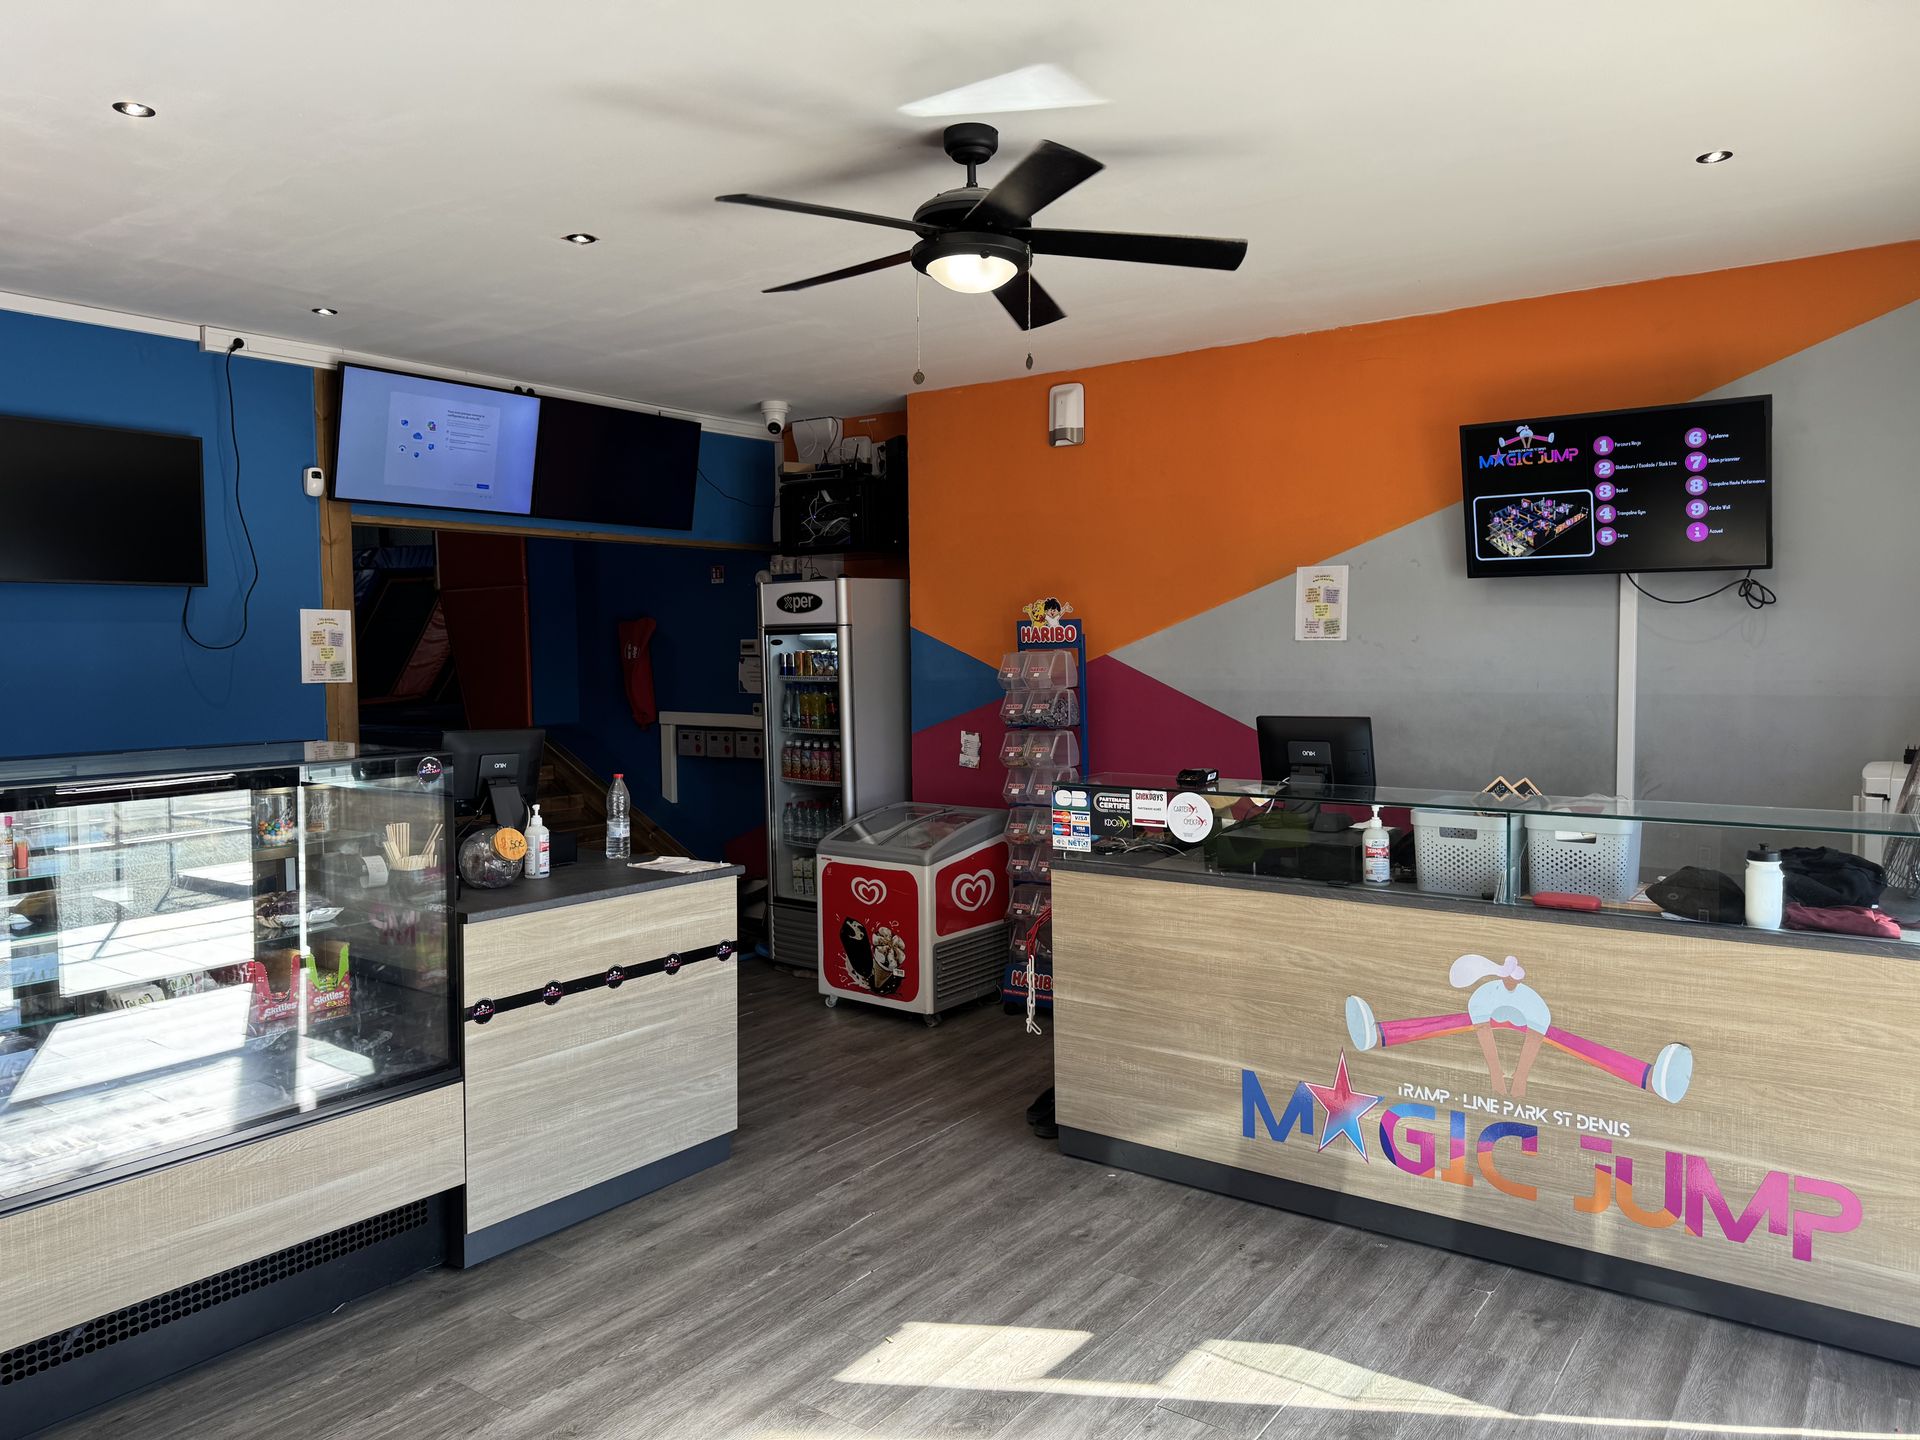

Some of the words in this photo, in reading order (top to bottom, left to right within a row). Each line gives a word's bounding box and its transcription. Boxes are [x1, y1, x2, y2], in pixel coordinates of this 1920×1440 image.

[1599, 439, 1609, 452] 1
[1688, 431, 1702, 445] 6
[1538, 448, 1579, 464] JUMP
[1690, 455, 1702, 469] 7
[1598, 461, 1611, 475] 2
[1598, 484, 1612, 498] 3
[1689, 478, 1704, 493] 8
[1600, 507, 1612, 520] 4
[1690, 502, 1704, 516] 9
[1600, 530, 1613, 543] 5
[783, 595, 814, 612] xper
[1020, 624, 1077, 643] HARIBO
[1054, 789, 1088, 807] CB
[1011, 970, 1053, 991] HARIB
[313, 990, 345, 1005] Skittles
[264, 1001, 298, 1017] Skittles
[1503, 1100, 1548, 1123] PARK
[1553, 1111, 1572, 1127] ST
[1576, 1114, 1631, 1138] DENIS
[1574, 1134, 1863, 1262] JUMP
